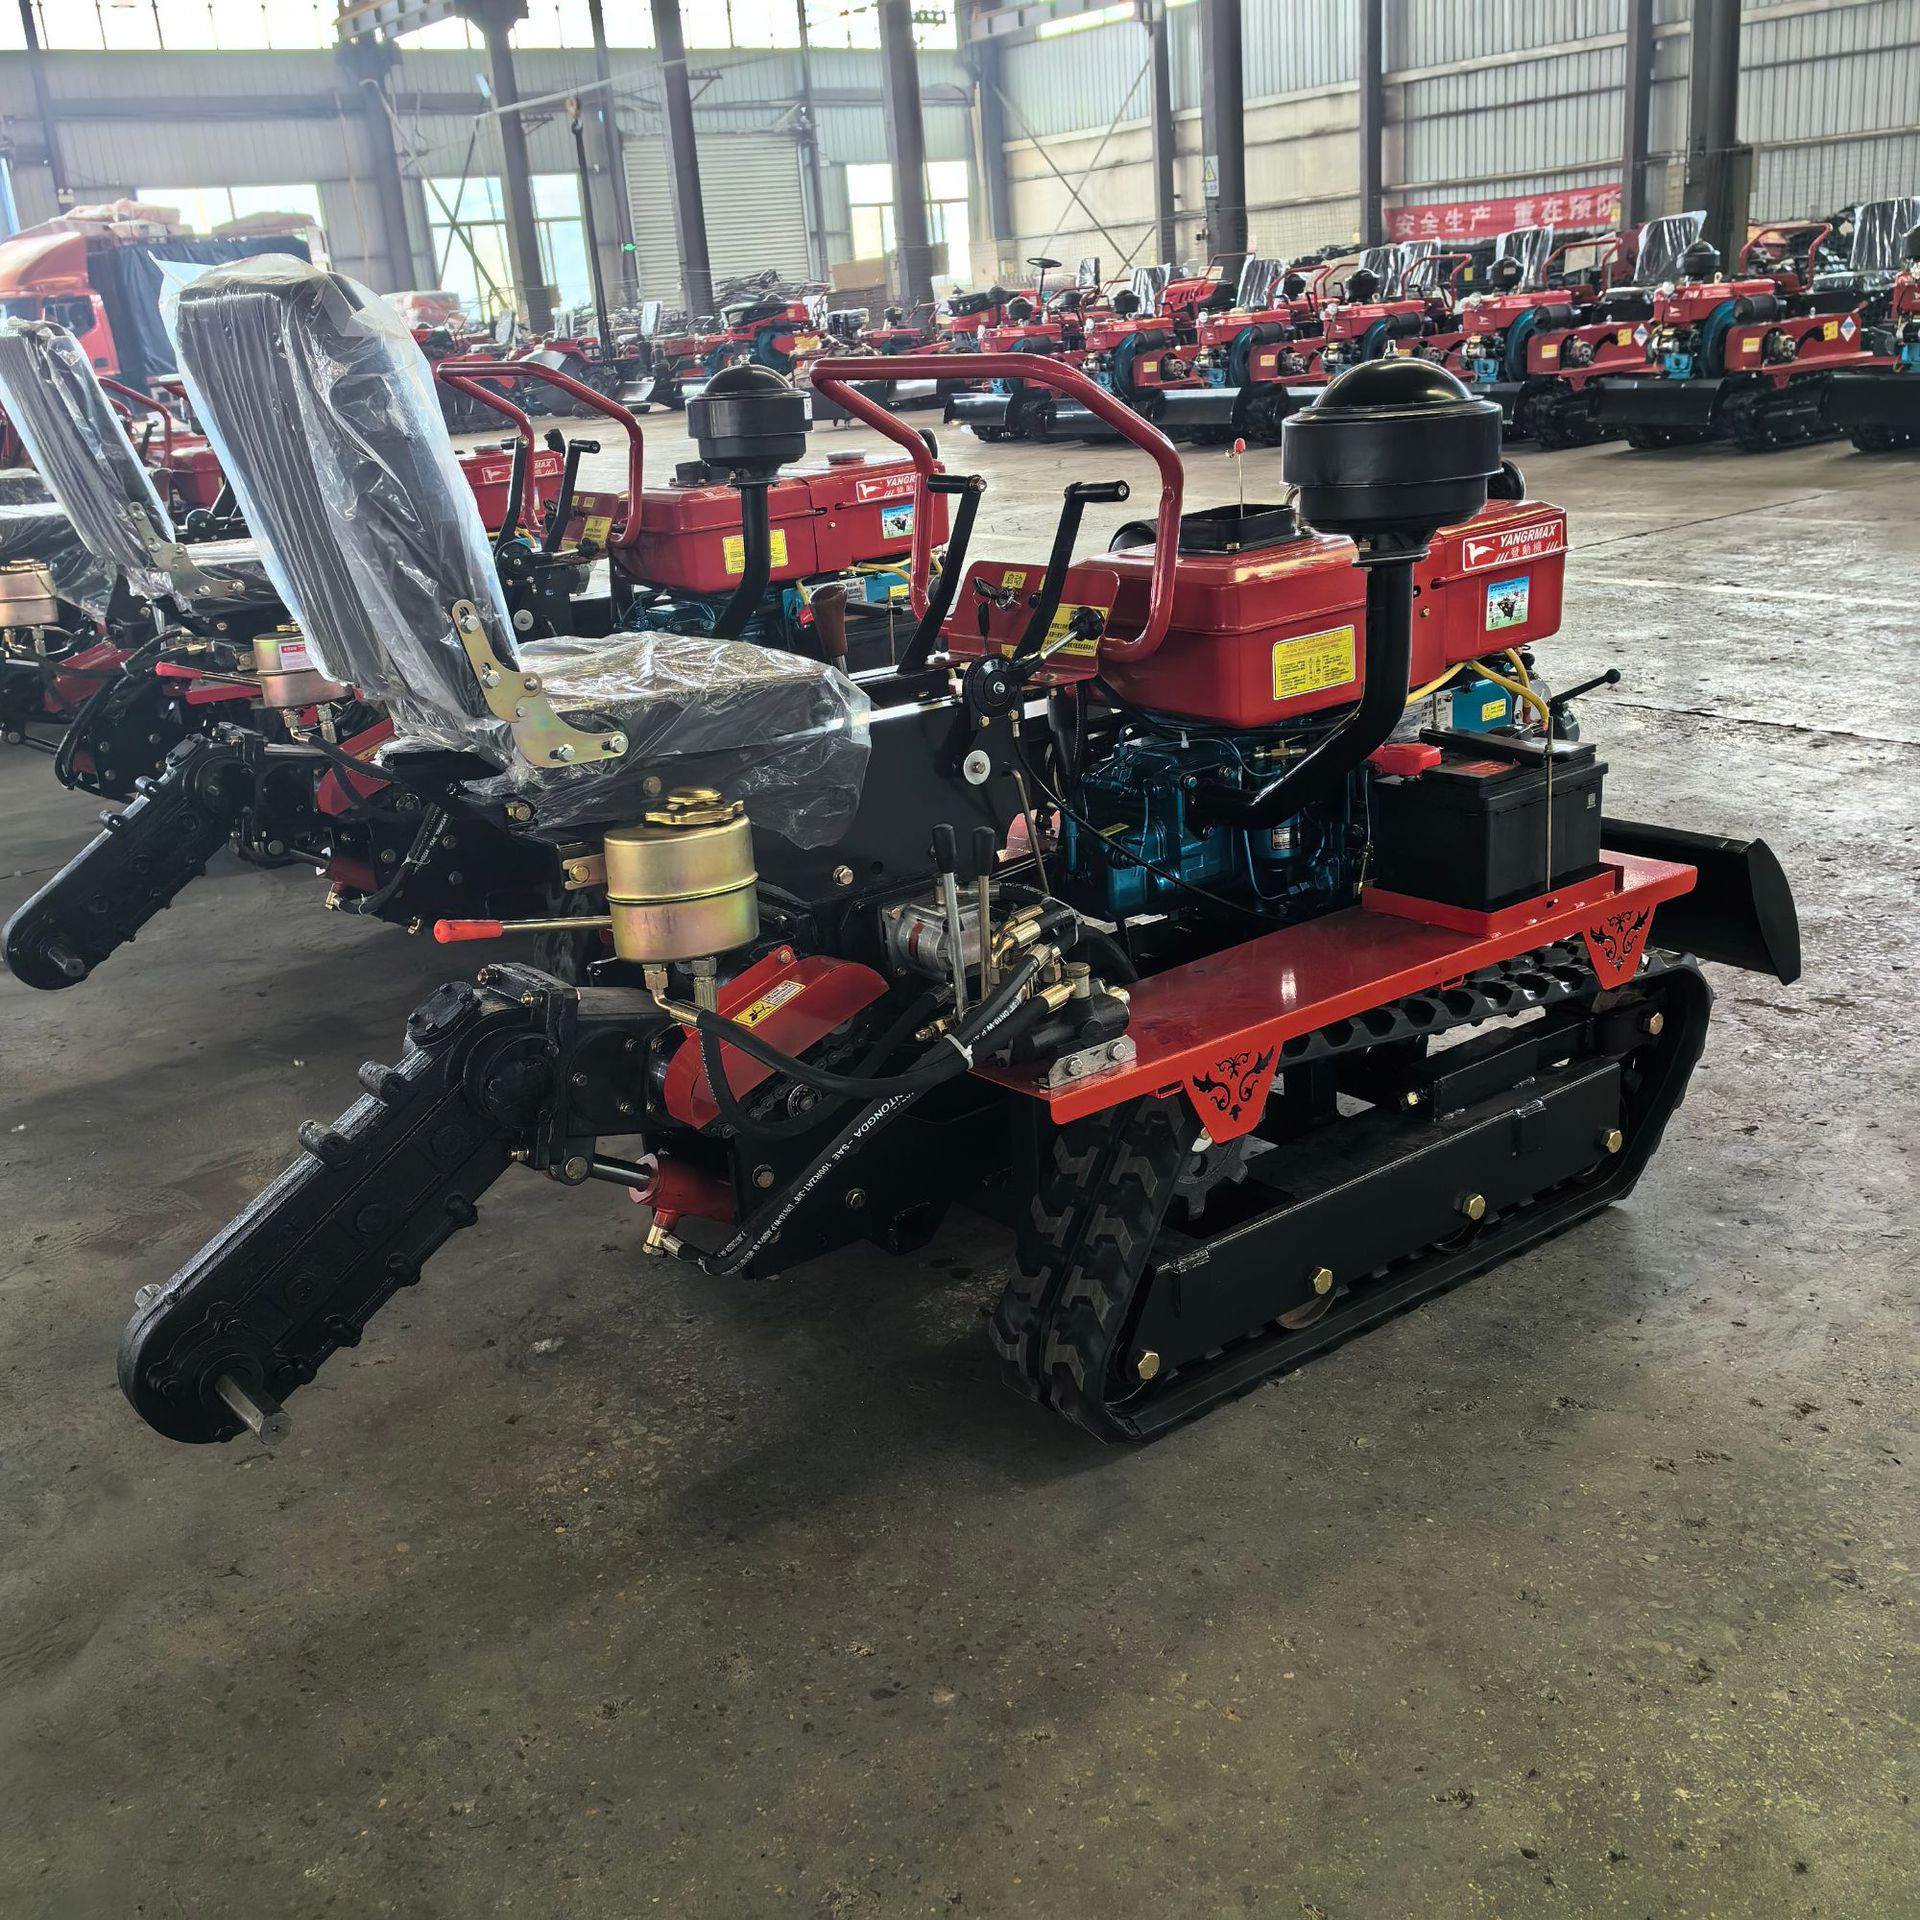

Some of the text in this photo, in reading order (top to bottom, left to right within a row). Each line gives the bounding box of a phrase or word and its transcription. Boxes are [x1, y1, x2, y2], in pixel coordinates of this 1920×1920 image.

[1395, 204, 1491, 237] 安全生产
[886, 474, 916, 488] YANGR
[1500, 524, 1557, 548] YANGRMAX
